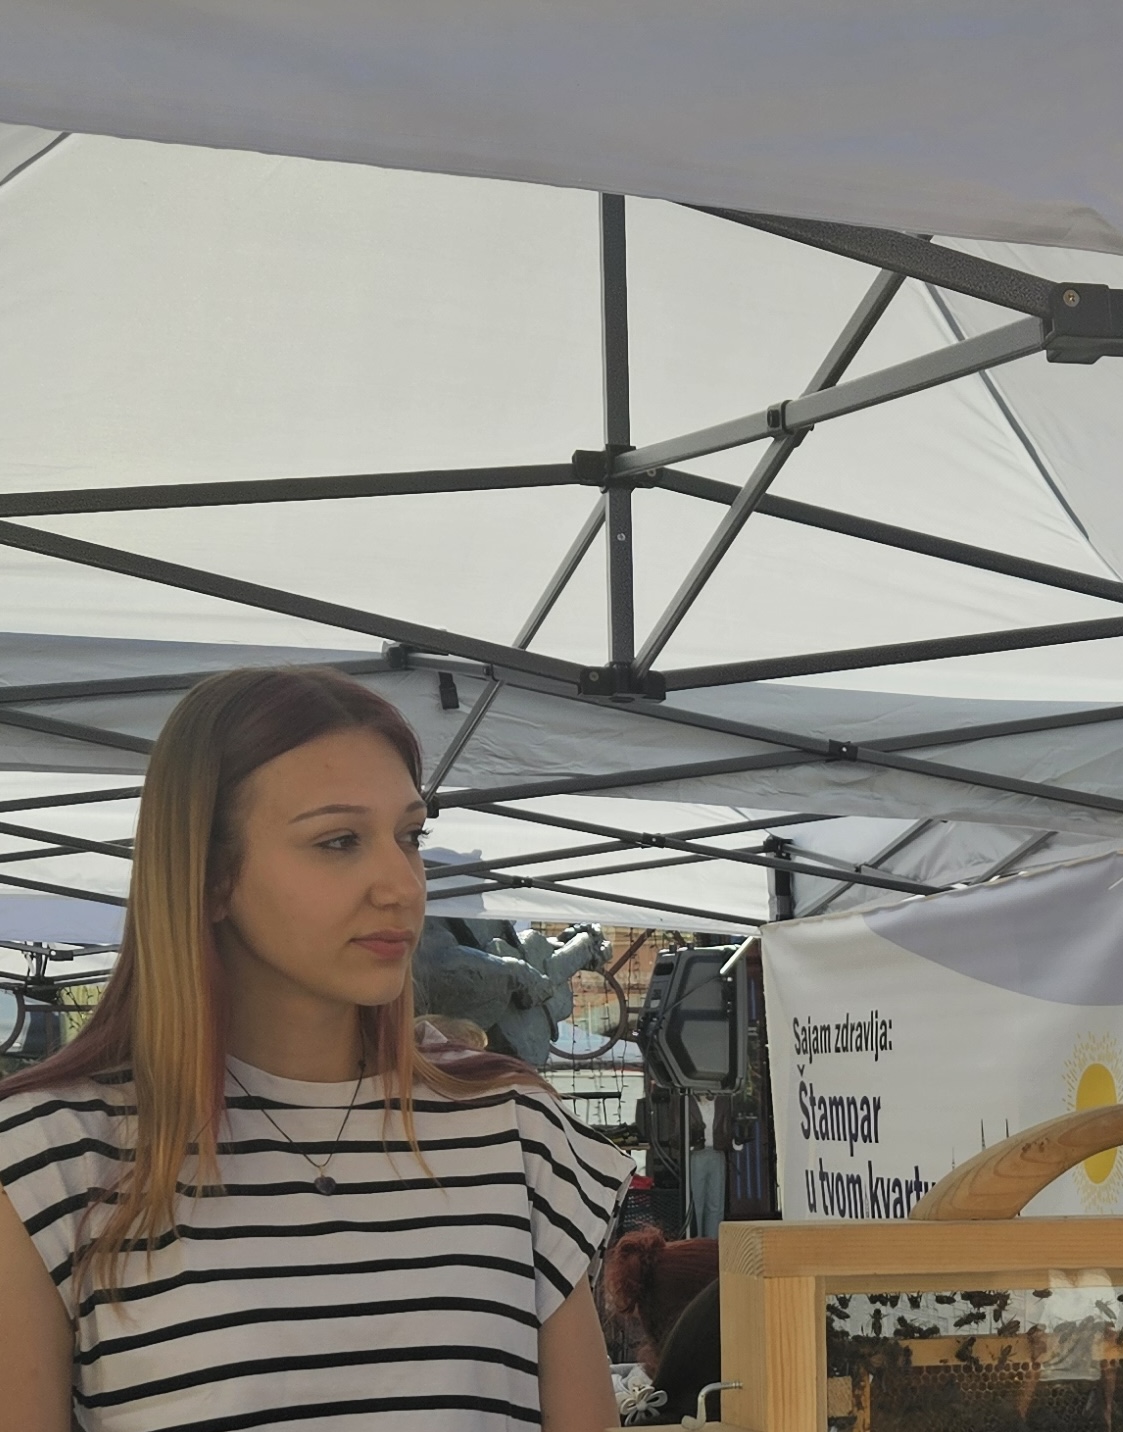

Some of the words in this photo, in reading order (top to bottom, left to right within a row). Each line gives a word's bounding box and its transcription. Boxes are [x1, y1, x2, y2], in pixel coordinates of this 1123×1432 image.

[793, 1015, 831, 1064] Sajam
[834, 1010, 893, 1062] zdravlja:
[798, 1064, 882, 1157] Štampar
[805, 1169, 817, 1213] u
[818, 1157, 865, 1219] tvom
[868, 1160, 936, 1219] kvart
